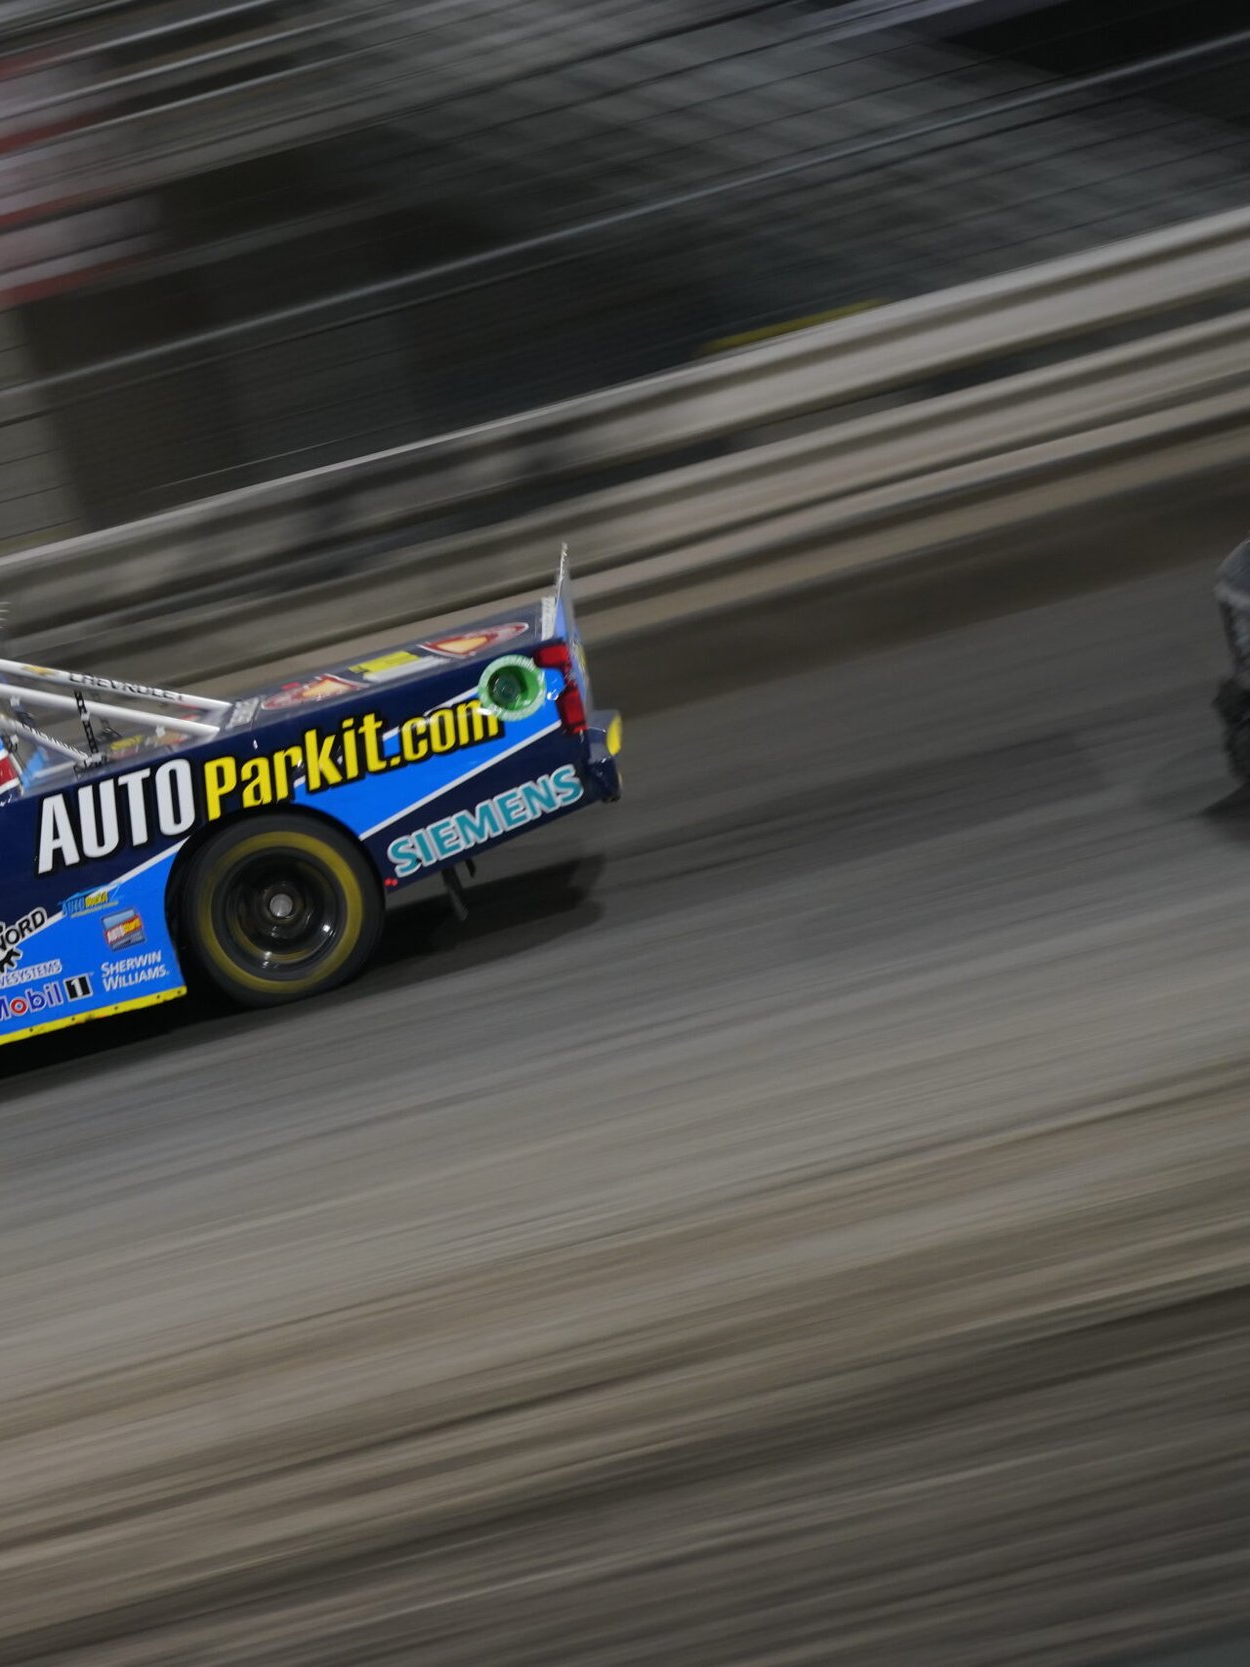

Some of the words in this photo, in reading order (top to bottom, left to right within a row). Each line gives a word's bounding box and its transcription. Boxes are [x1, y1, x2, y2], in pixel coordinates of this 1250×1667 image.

[386, 763, 585, 878] SIEMENS
[101, 950, 162, 978] SHERWIN
[102, 964, 168, 992] WILLIAMS
